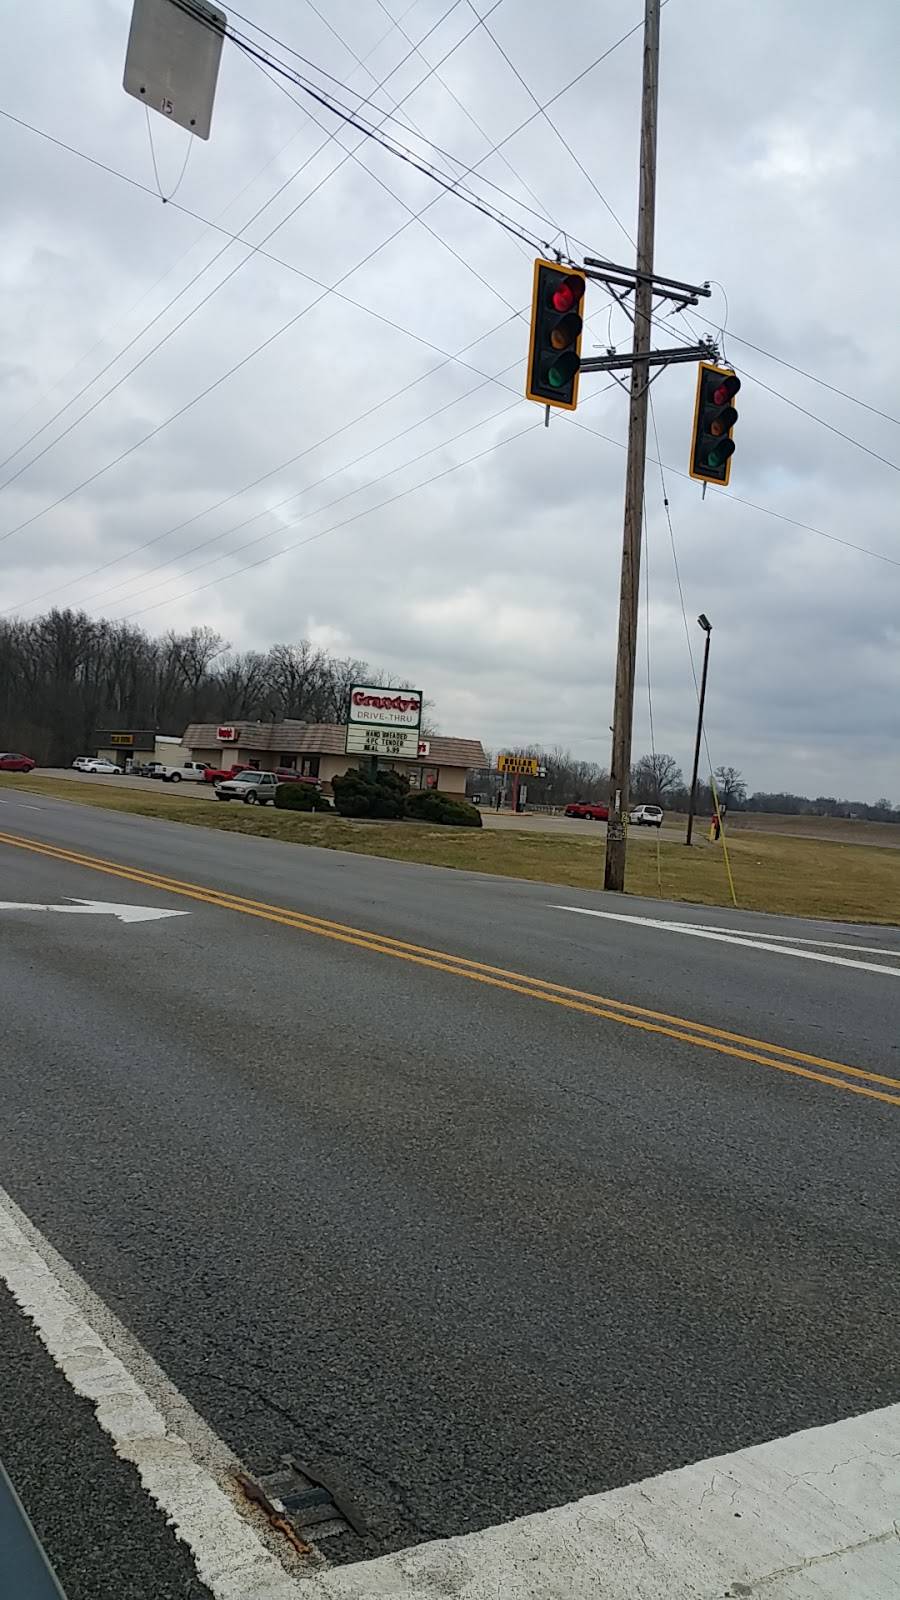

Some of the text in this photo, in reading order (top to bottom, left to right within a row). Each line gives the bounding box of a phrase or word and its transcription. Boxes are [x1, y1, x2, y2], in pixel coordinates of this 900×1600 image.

[161, 98, 174, 115] 15
[353, 691, 420, 712] Grandy's
[357, 711, 412, 722] DRIVE-THRU
[365, 730, 407, 740] HAND BREADED
